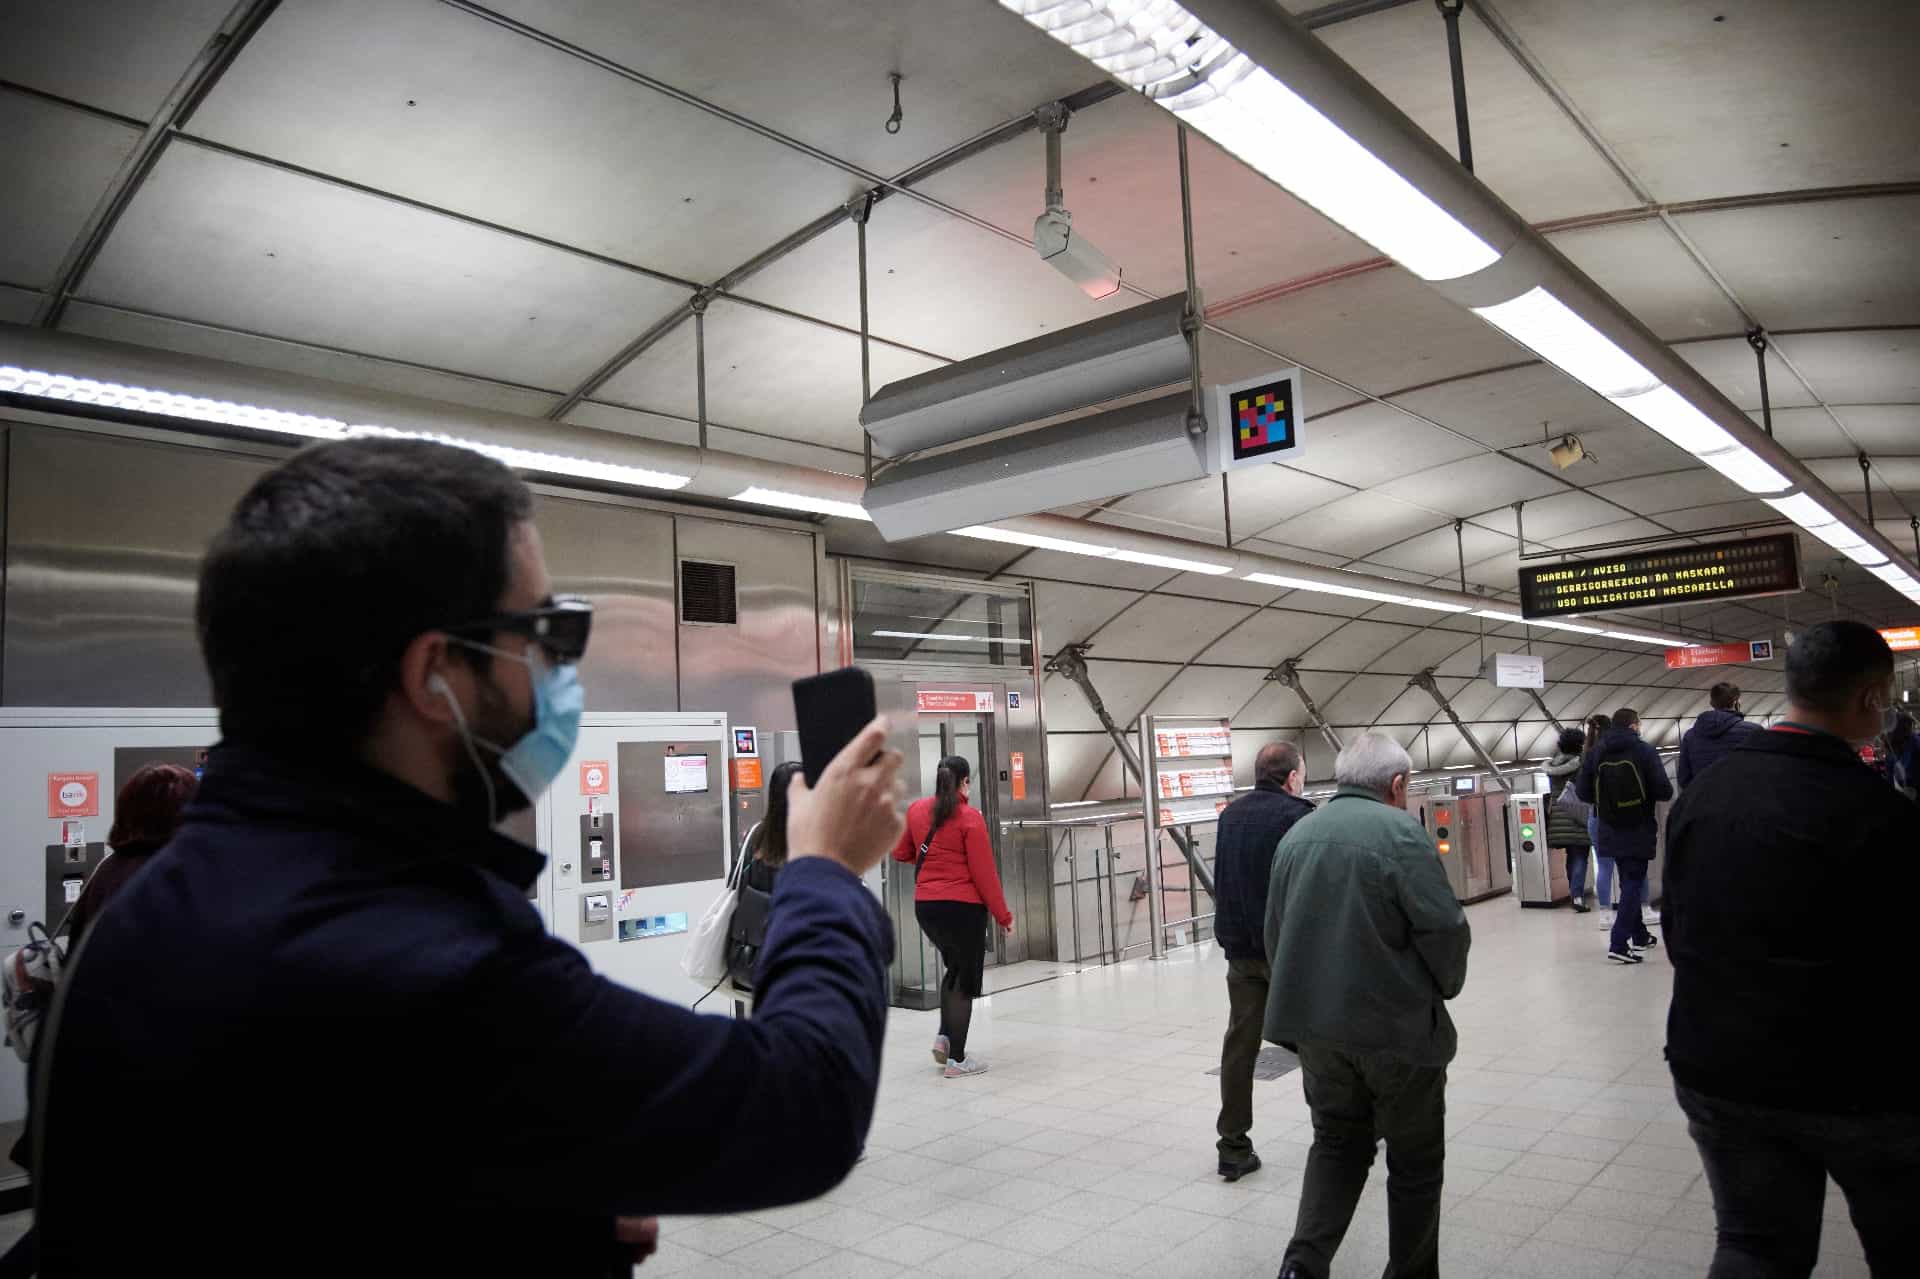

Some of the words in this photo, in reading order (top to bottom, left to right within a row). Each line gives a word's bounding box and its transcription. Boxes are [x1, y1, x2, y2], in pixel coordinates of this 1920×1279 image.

[1593, 563, 1626, 576] AVISO
[1675, 565, 1726, 580] MASKARA
[1557, 598, 1577, 608] USO
[1583, 588, 1656, 605] OBLIGATORIO
[1663, 579, 1734, 596] MASCARILLA
